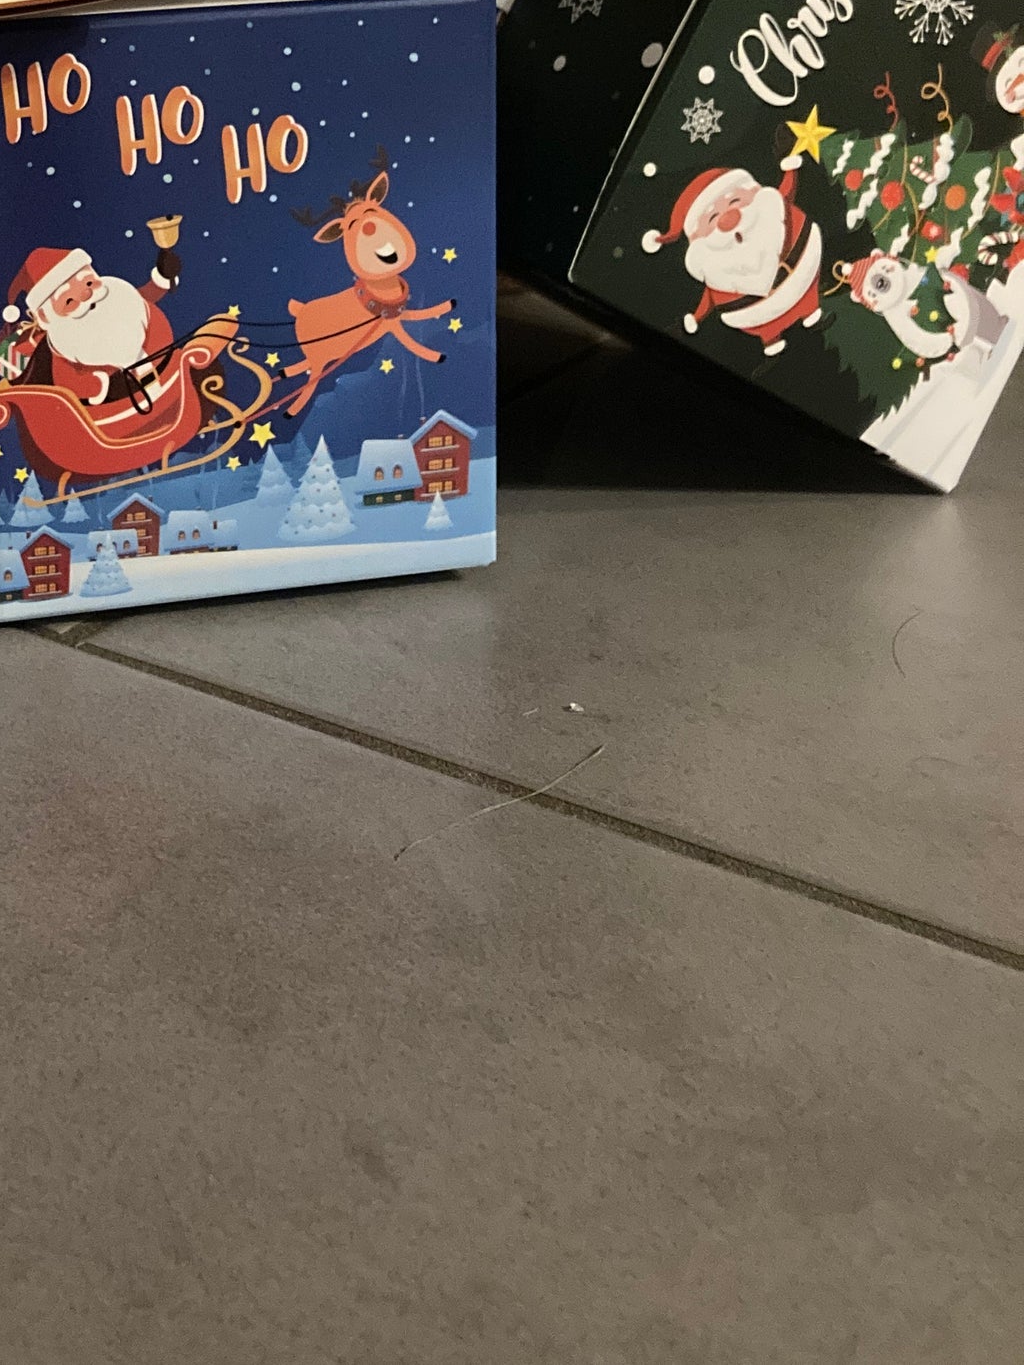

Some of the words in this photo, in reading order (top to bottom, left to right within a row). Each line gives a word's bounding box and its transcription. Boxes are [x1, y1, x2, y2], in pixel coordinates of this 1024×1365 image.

[0, 53, 91, 144] HO
[115, 85, 205, 176] HO
[221, 114, 309, 204] HO
